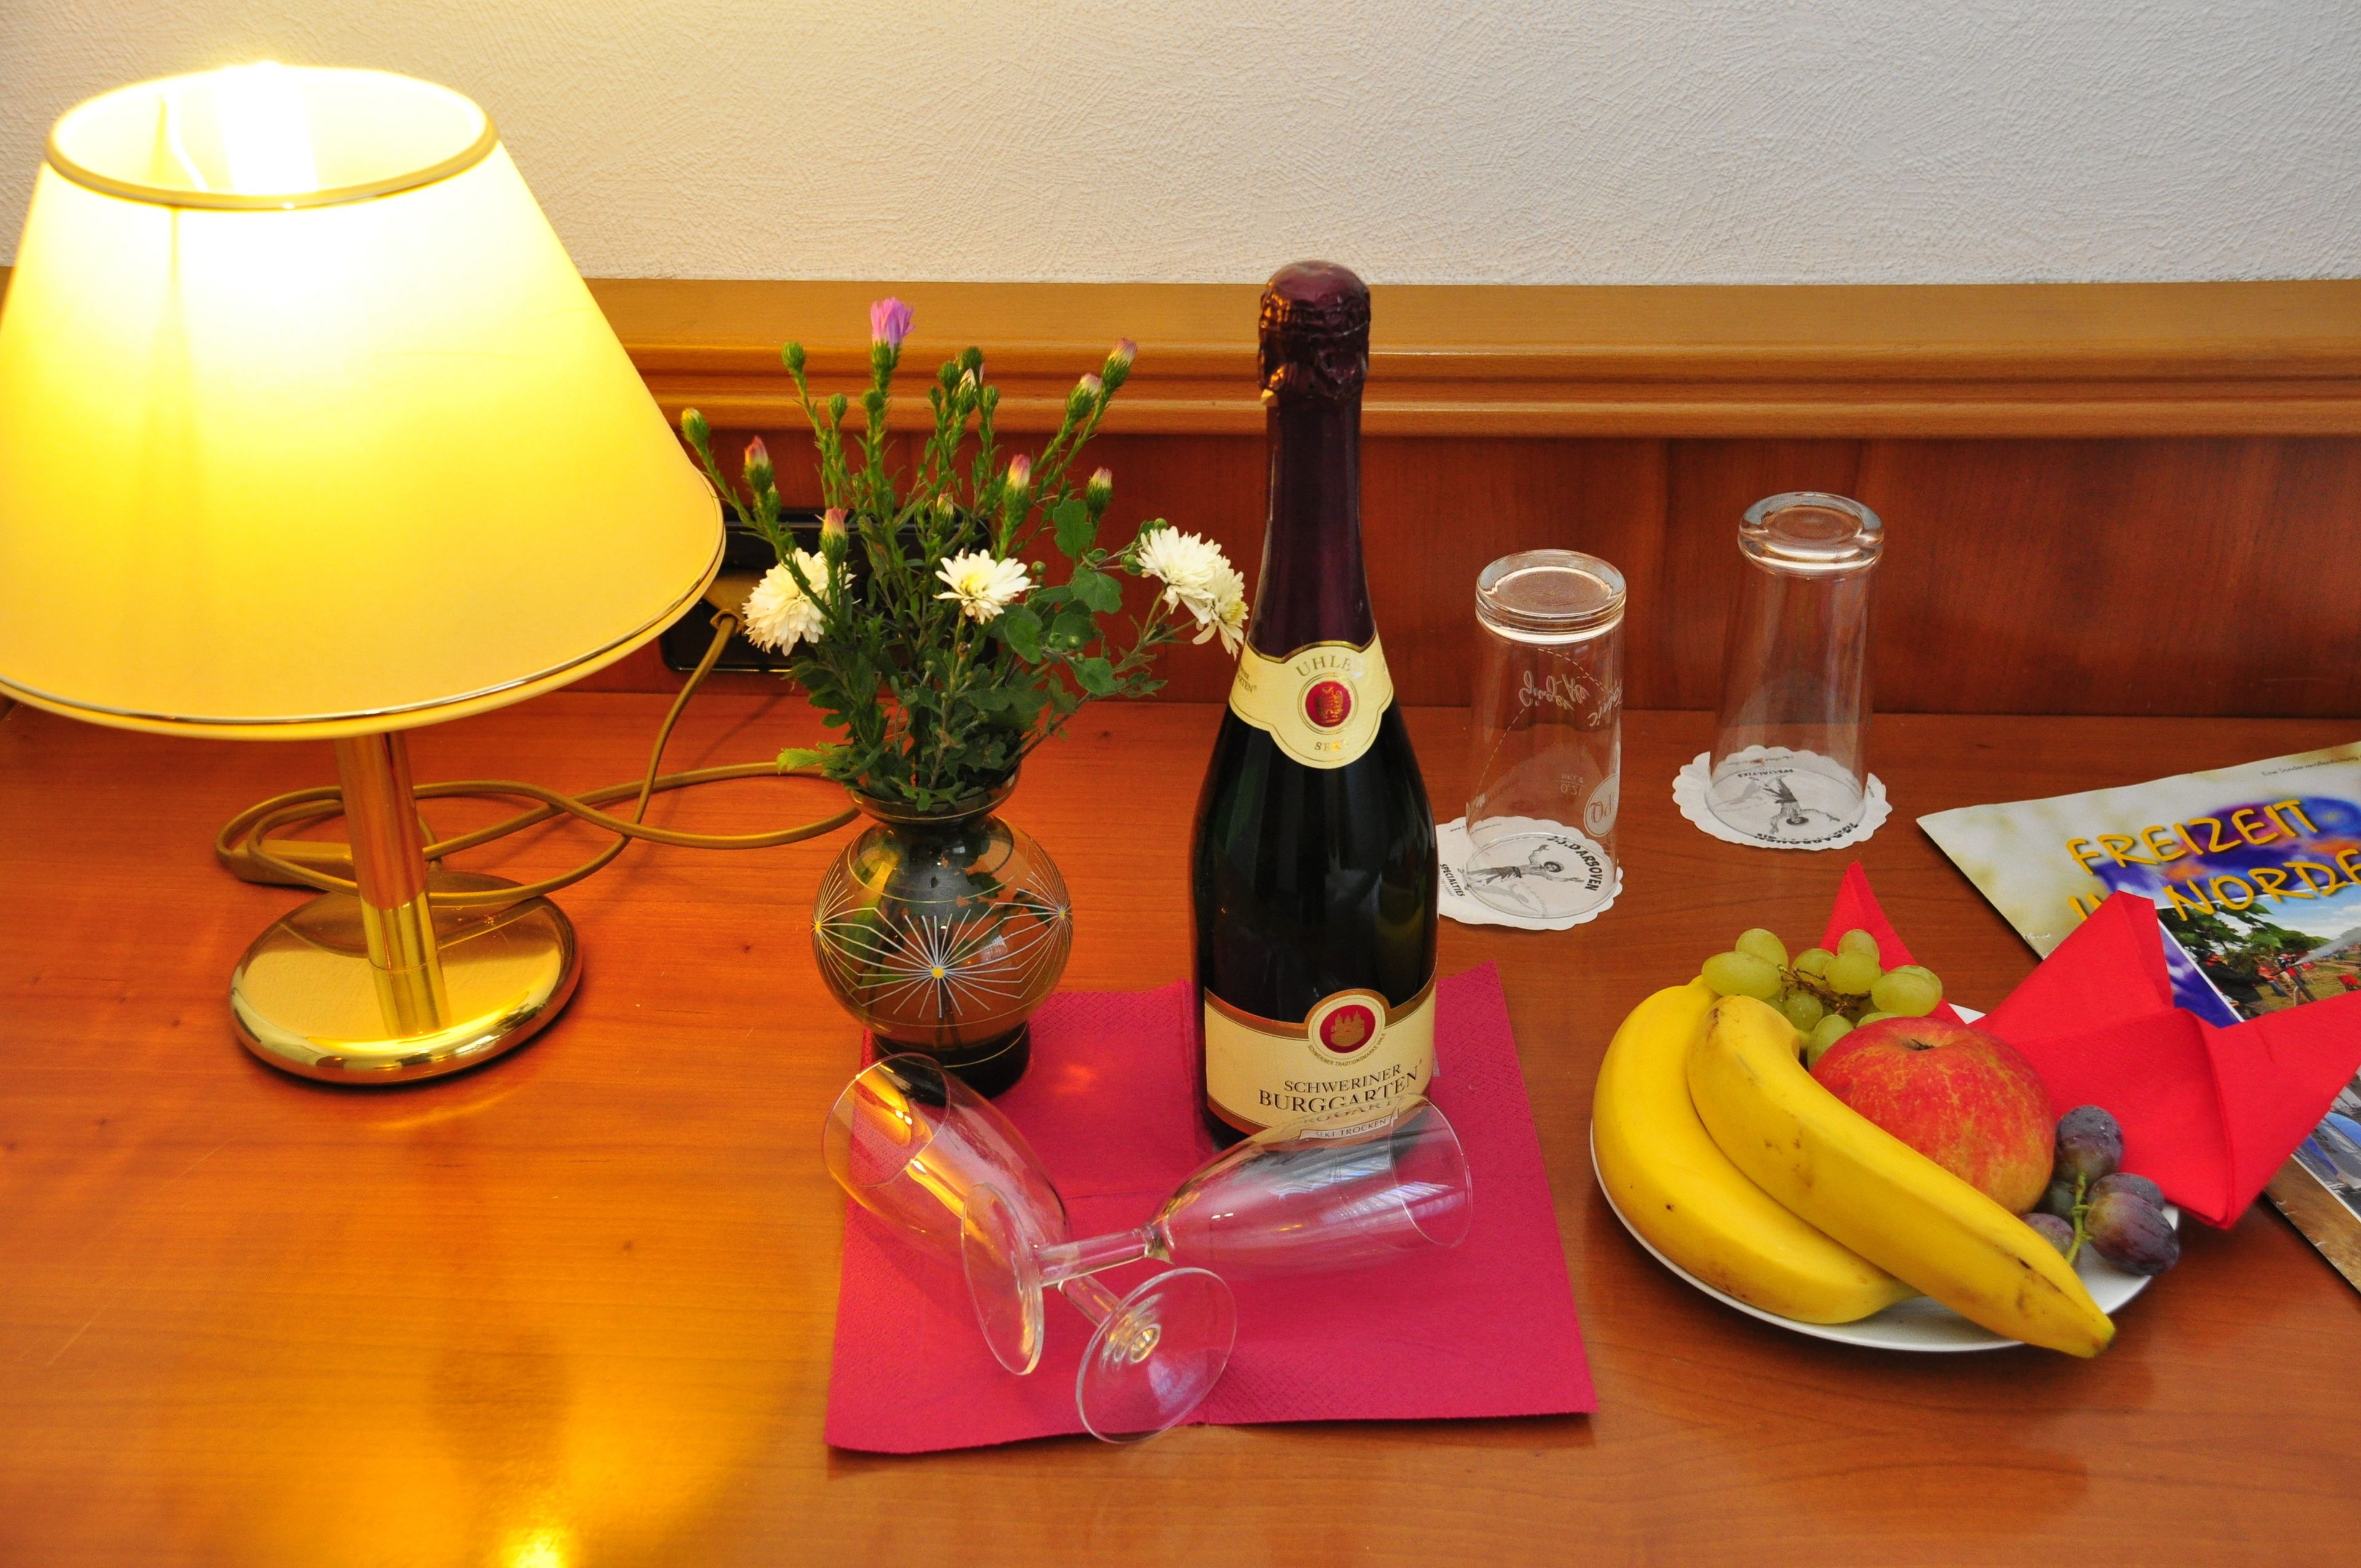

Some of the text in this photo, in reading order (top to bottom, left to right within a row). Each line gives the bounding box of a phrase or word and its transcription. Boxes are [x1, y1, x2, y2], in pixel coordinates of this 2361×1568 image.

[2065, 799, 2318, 875] FREIZEIT
[1439, 863, 1466, 898] SPECIALTIES
[1259, 1064, 1419, 1114] BURGGARTEN
[1284, 1063, 1401, 1093] SCHWERINER
[1339, 1118, 1386, 1136] TROCKEN
